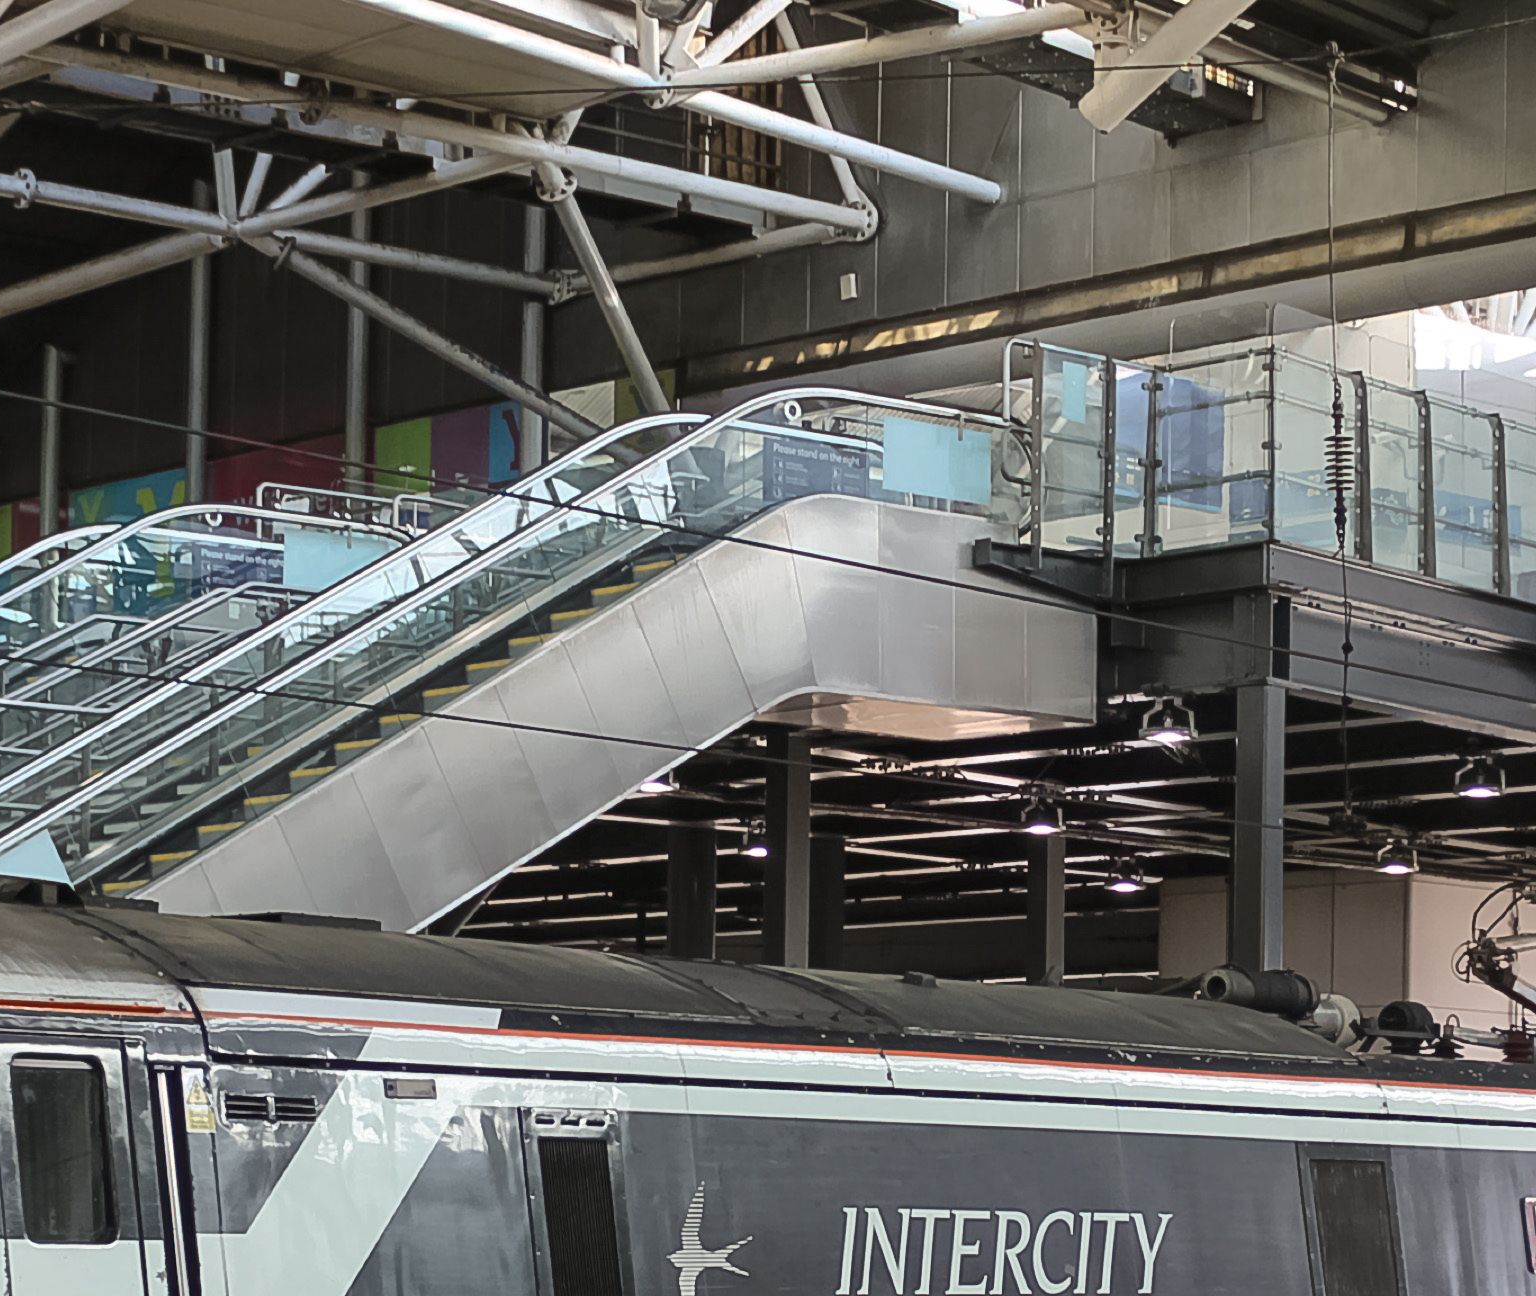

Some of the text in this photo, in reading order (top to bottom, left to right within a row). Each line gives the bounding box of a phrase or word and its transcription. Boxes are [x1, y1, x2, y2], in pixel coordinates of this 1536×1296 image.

[773, 442, 860, 468] Please stand on the right
[201, 548, 224, 560] Please
[255, 556, 267, 566] the
[834, 1206, 1174, 1296] INTERCITY
